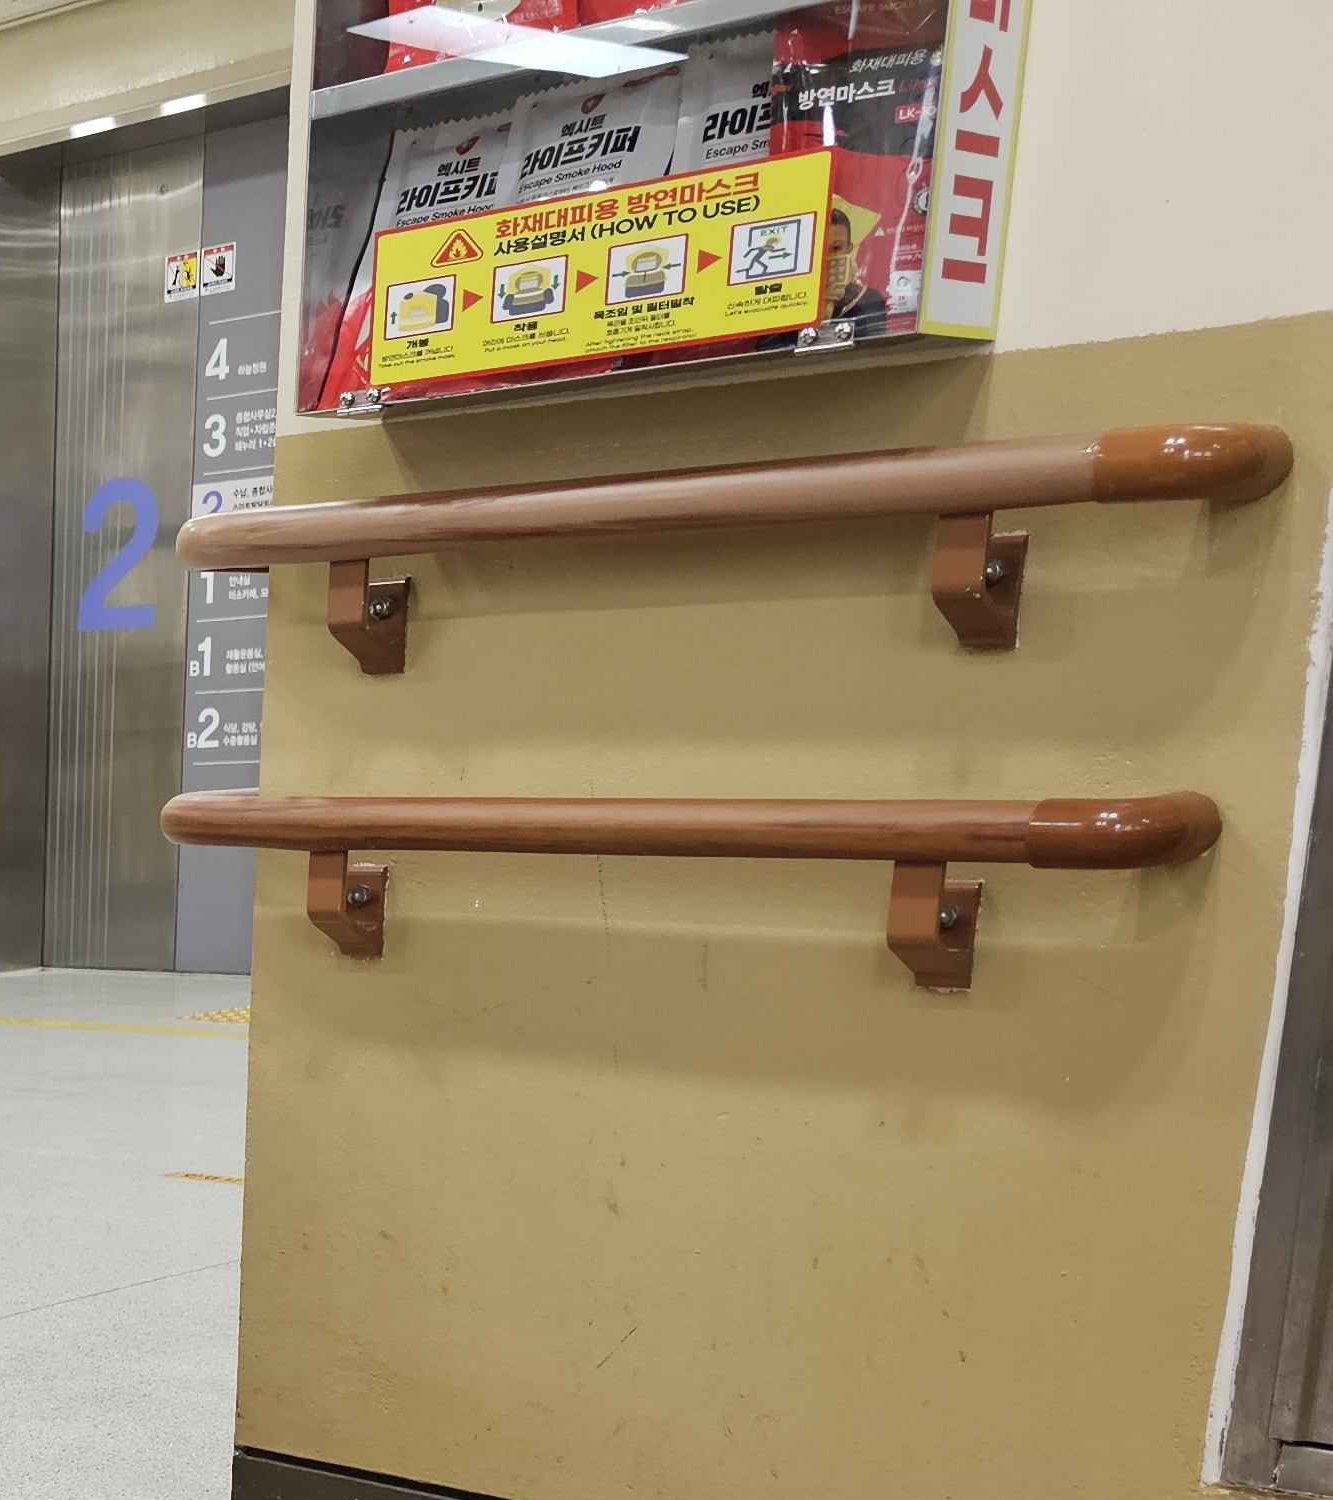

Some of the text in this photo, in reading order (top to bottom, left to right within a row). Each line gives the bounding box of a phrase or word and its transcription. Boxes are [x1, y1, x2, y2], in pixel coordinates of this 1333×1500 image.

[849, 48, 927, 74] 화재대피용
[751, 80, 771, 99] 엑
[798, 77, 895, 111] 방연마스크
[561, 113, 606, 138] 엑시트
[436, 156, 481, 178] 엑시트
[519, 125, 641, 180] 라이프키퍼
[704, 142, 749, 160] Escape
[518, 159, 623, 195] Escape Smoke Hood
[395, 213, 430, 229] Escape
[430, 208, 466, 222] Smoke
[495, 171, 760, 239] 화재대피용 방연마스크
[493, 194, 761, 257] 사용설명서 (HOW TO USE)
[759, 225, 788, 237] EXIT
[593, 295, 695, 320] 목조임 및 필터밀착
[204, 337, 230, 381] 4
[202, 413, 227, 458] 3
[77, 476, 160, 633] 2
[200, 571, 215, 605] 1
